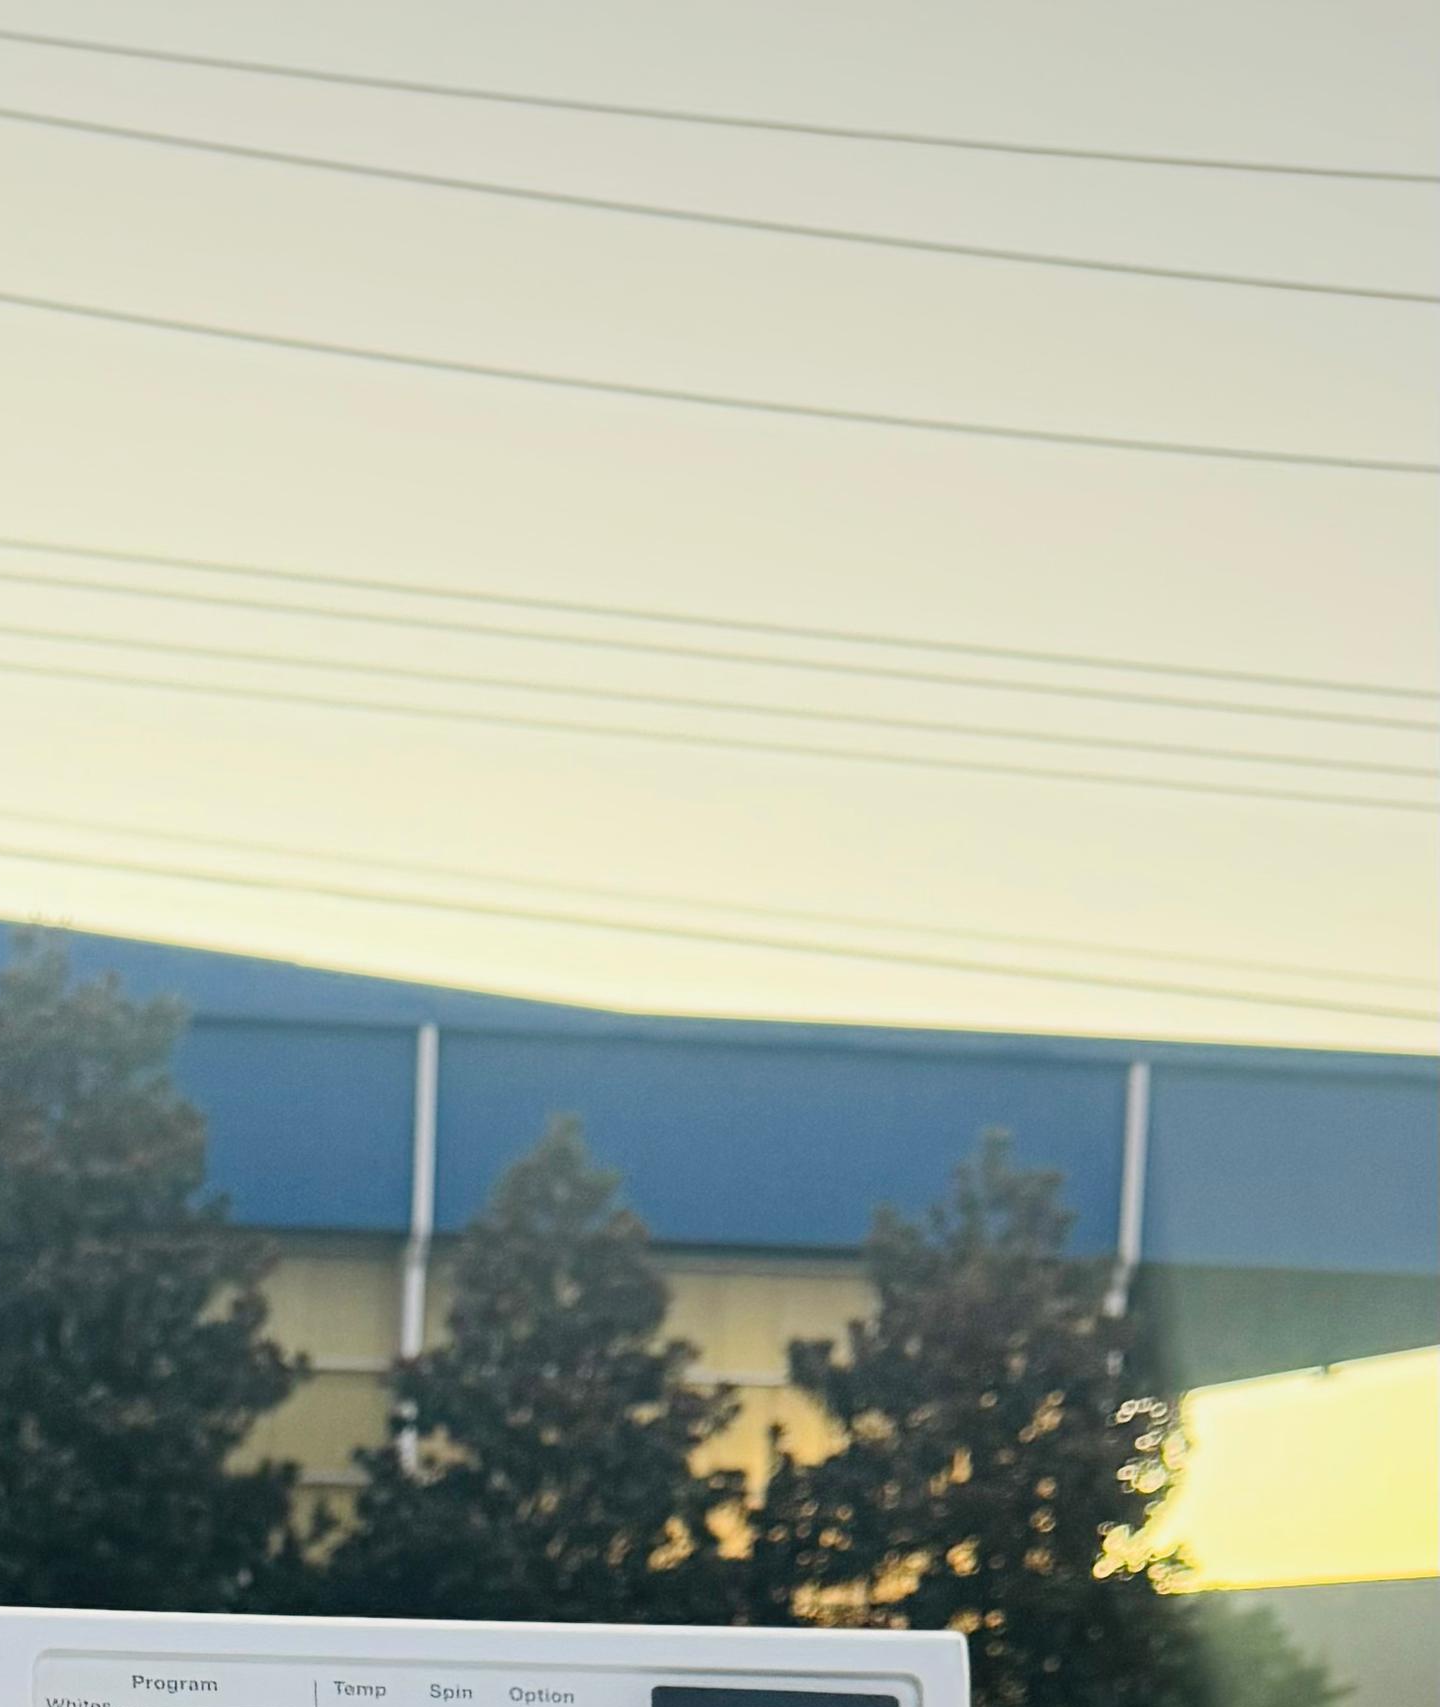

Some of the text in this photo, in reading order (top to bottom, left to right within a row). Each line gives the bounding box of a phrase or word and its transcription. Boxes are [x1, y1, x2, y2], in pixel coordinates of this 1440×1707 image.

[131, 1674, 219, 1693] Program
[333, 1681, 387, 1699] Temp
[429, 1684, 473, 1701] Spin
[509, 1686, 575, 1705] Option
